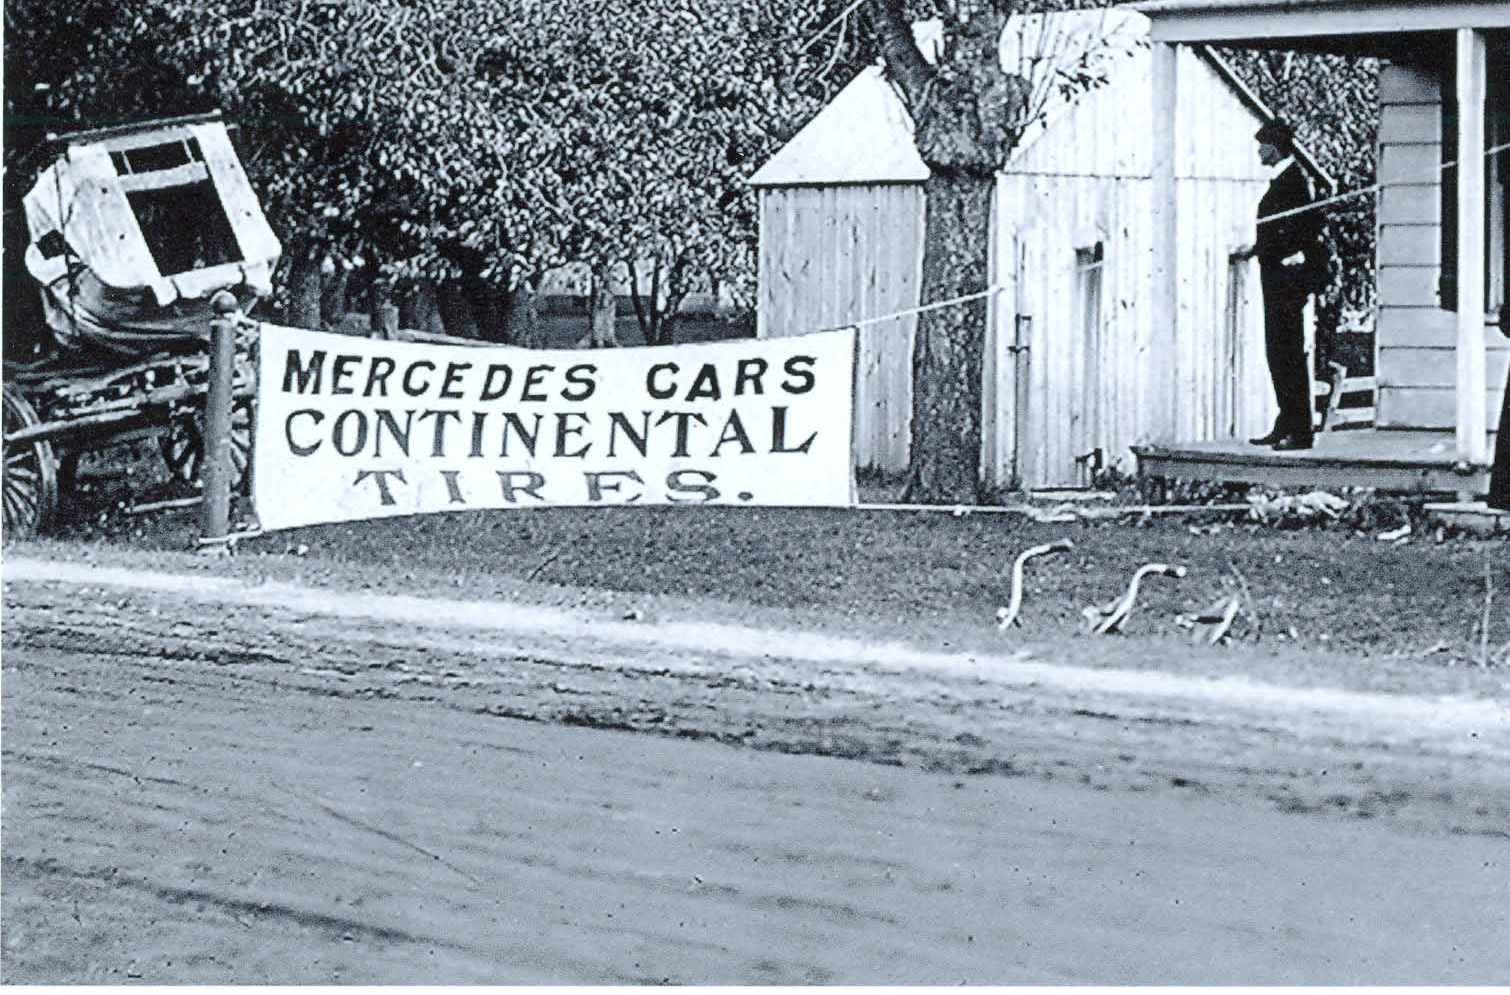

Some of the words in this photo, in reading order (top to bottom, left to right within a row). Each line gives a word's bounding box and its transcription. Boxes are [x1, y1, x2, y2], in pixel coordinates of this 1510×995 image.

[282, 349, 597, 402] MERCEDES
[646, 355, 818, 402] CARS
[285, 406, 818, 459] CONTINENTAL
[353, 469, 754, 506] TIRES.
